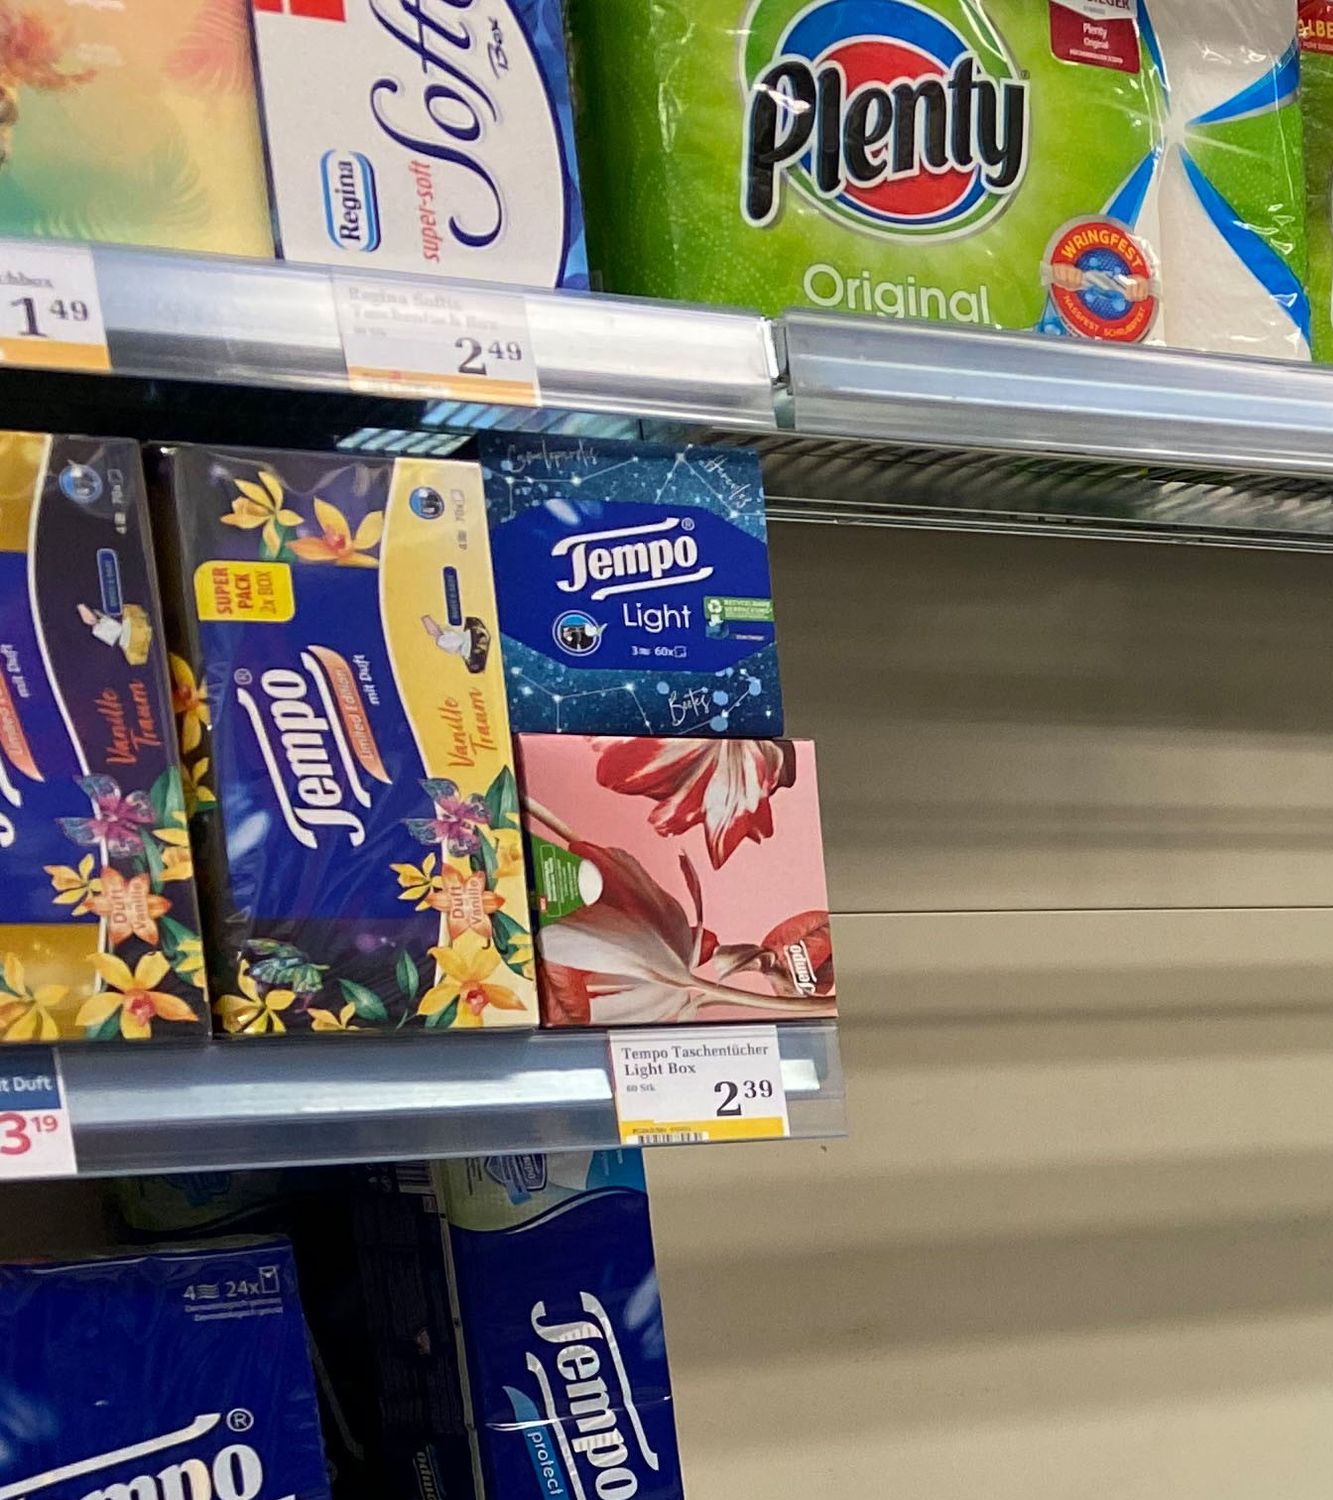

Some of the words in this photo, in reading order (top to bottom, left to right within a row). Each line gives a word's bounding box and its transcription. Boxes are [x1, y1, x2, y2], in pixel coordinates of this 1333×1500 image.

[748, 58, 1026, 222] Plenty
[337, 161, 362, 242] Regina
[410, 160, 444, 264] super-soft
[1060, 229, 1144, 269] WRINGFEST
[803, 264, 990, 325] Original
[551, 518, 699, 594] Tempo
[211, 566, 232, 616] SUPER
[233, 573, 254, 610] PACK
[254, 570, 276, 597] BOX
[622, 602, 693, 634] Light
[353, 653, 371, 682] Duft
[97, 687, 137, 766] Vanille
[438, 696, 475, 768] Vanille
[468, 687, 498, 758] Traum
[237, 669, 367, 849] Tempo
[111, 881, 127, 924] Duft
[450, 884, 466, 920] Duft
[469, 879, 482, 926] Vanille
[784, 941, 817, 996] Tempo
[621, 1046, 669, 1063] Tempo
[672, 1043, 769, 1060] Taschentücher
[624, 1062, 663, 1080] Light
[668, 1062, 697, 1076] Box
[13, 1075, 53, 1092] Duft
[182, 1283, 197, 1301] 4
[224, 1279, 260, 1299] 24x
[527, 1430, 565, 1497] protect
